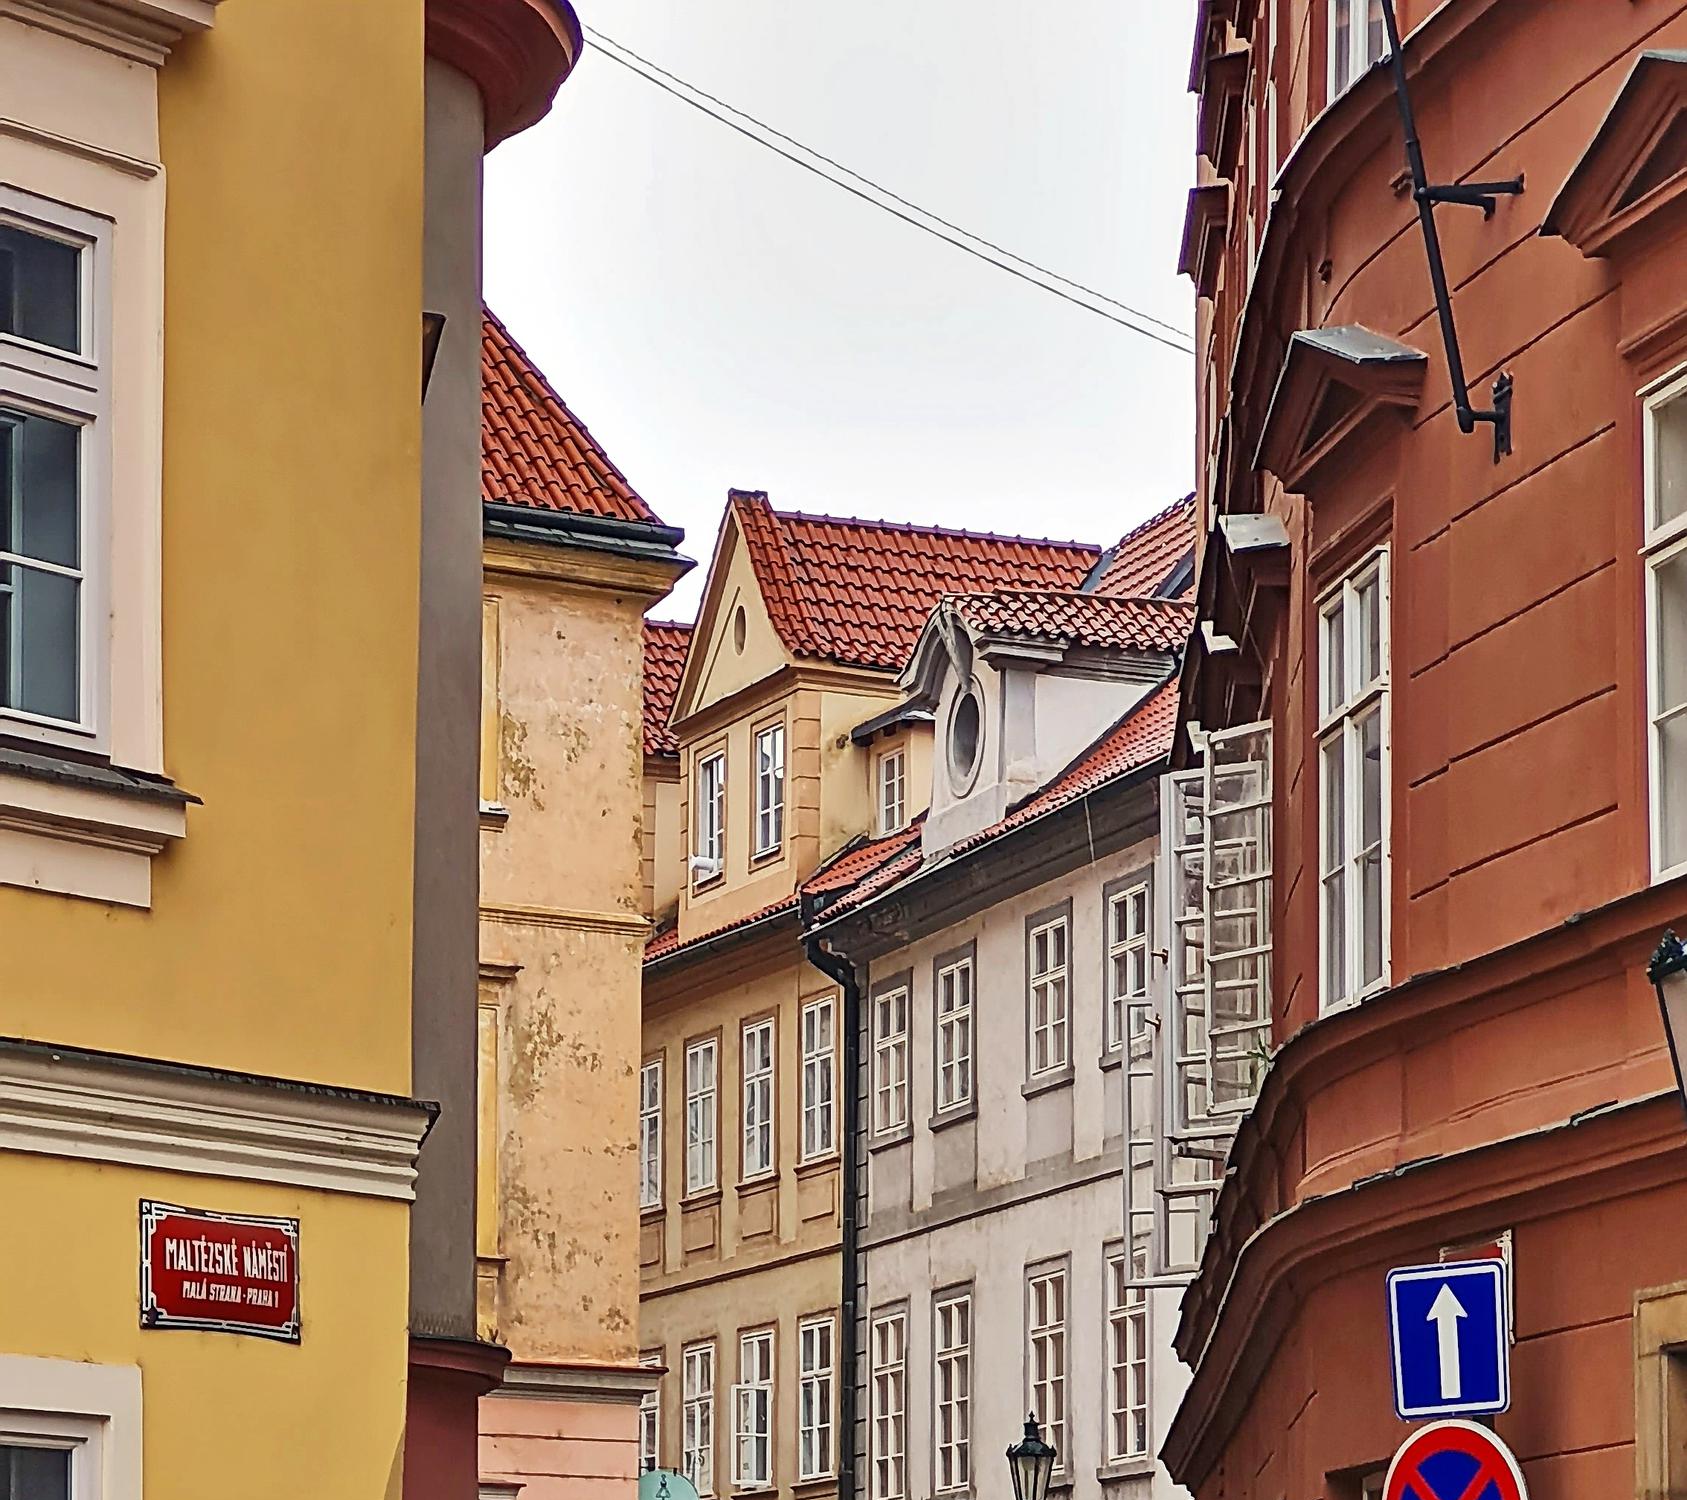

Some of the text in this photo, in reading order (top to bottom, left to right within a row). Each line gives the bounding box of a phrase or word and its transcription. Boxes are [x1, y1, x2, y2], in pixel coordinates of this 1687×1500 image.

[165, 1234, 288, 1283] MALTÉZSKÉ NÁMĚSTÍ
[182, 1278, 207, 1299] MALÁ
